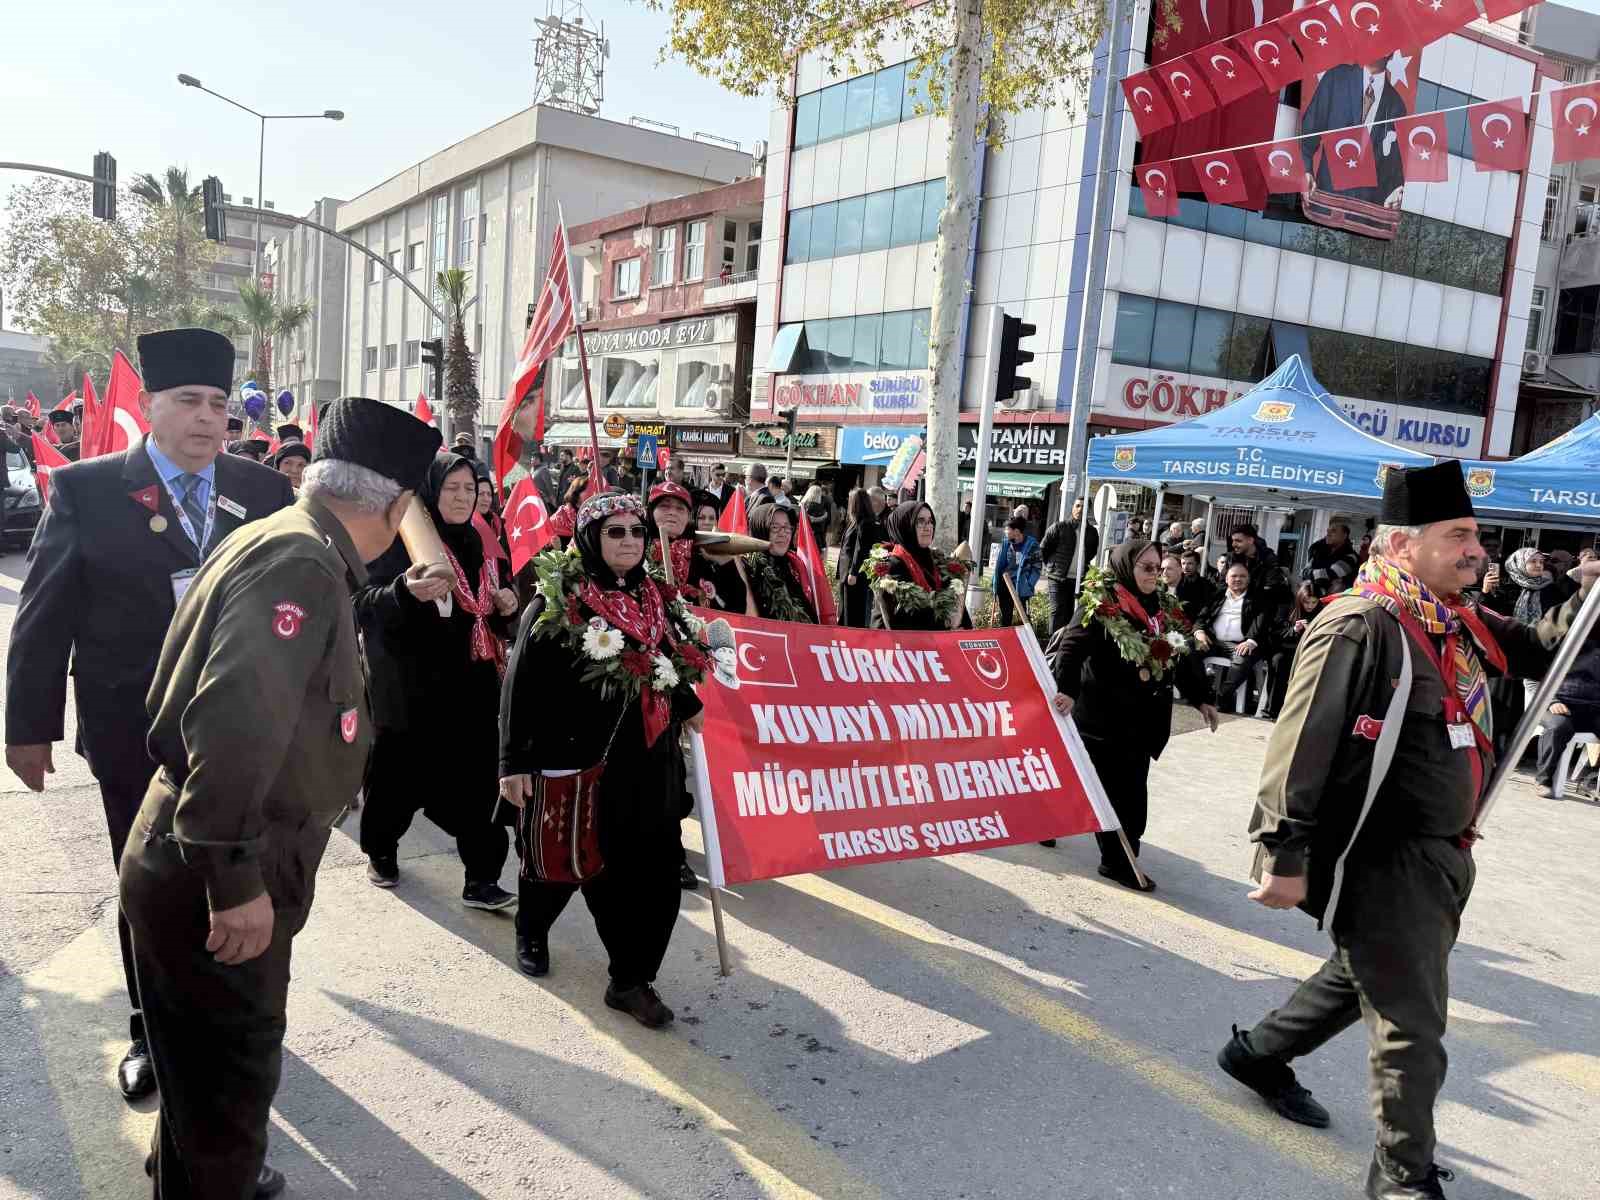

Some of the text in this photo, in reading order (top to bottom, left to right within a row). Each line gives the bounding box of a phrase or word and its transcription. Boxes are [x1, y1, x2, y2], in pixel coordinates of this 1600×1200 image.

[626, 327, 671, 348] MODA
[676, 319, 708, 343] EVİ
[776, 379, 862, 407] GÖKHAN
[1125, 374, 1244, 416] GÖKH
[863, 431, 899, 449] beko
[971, 426, 1056, 445] VTAMİN
[1344, 403, 1471, 448] CÜ KURSU
[957, 445, 1065, 465] ŞAKÜTER
[1237, 447, 1267, 462] T.C.
[1163, 460, 1344, 486] TARSUS BELEDİYESİ
[809, 640, 950, 683] TÜRKİYE
[750, 697, 1017, 744] KUVAYİ MİLLİYE
[732, 747, 1061, 817] MÜCAHİTLER DERNEĞİ
[819, 810, 1010, 860] TARSUS ŞUBESİ
